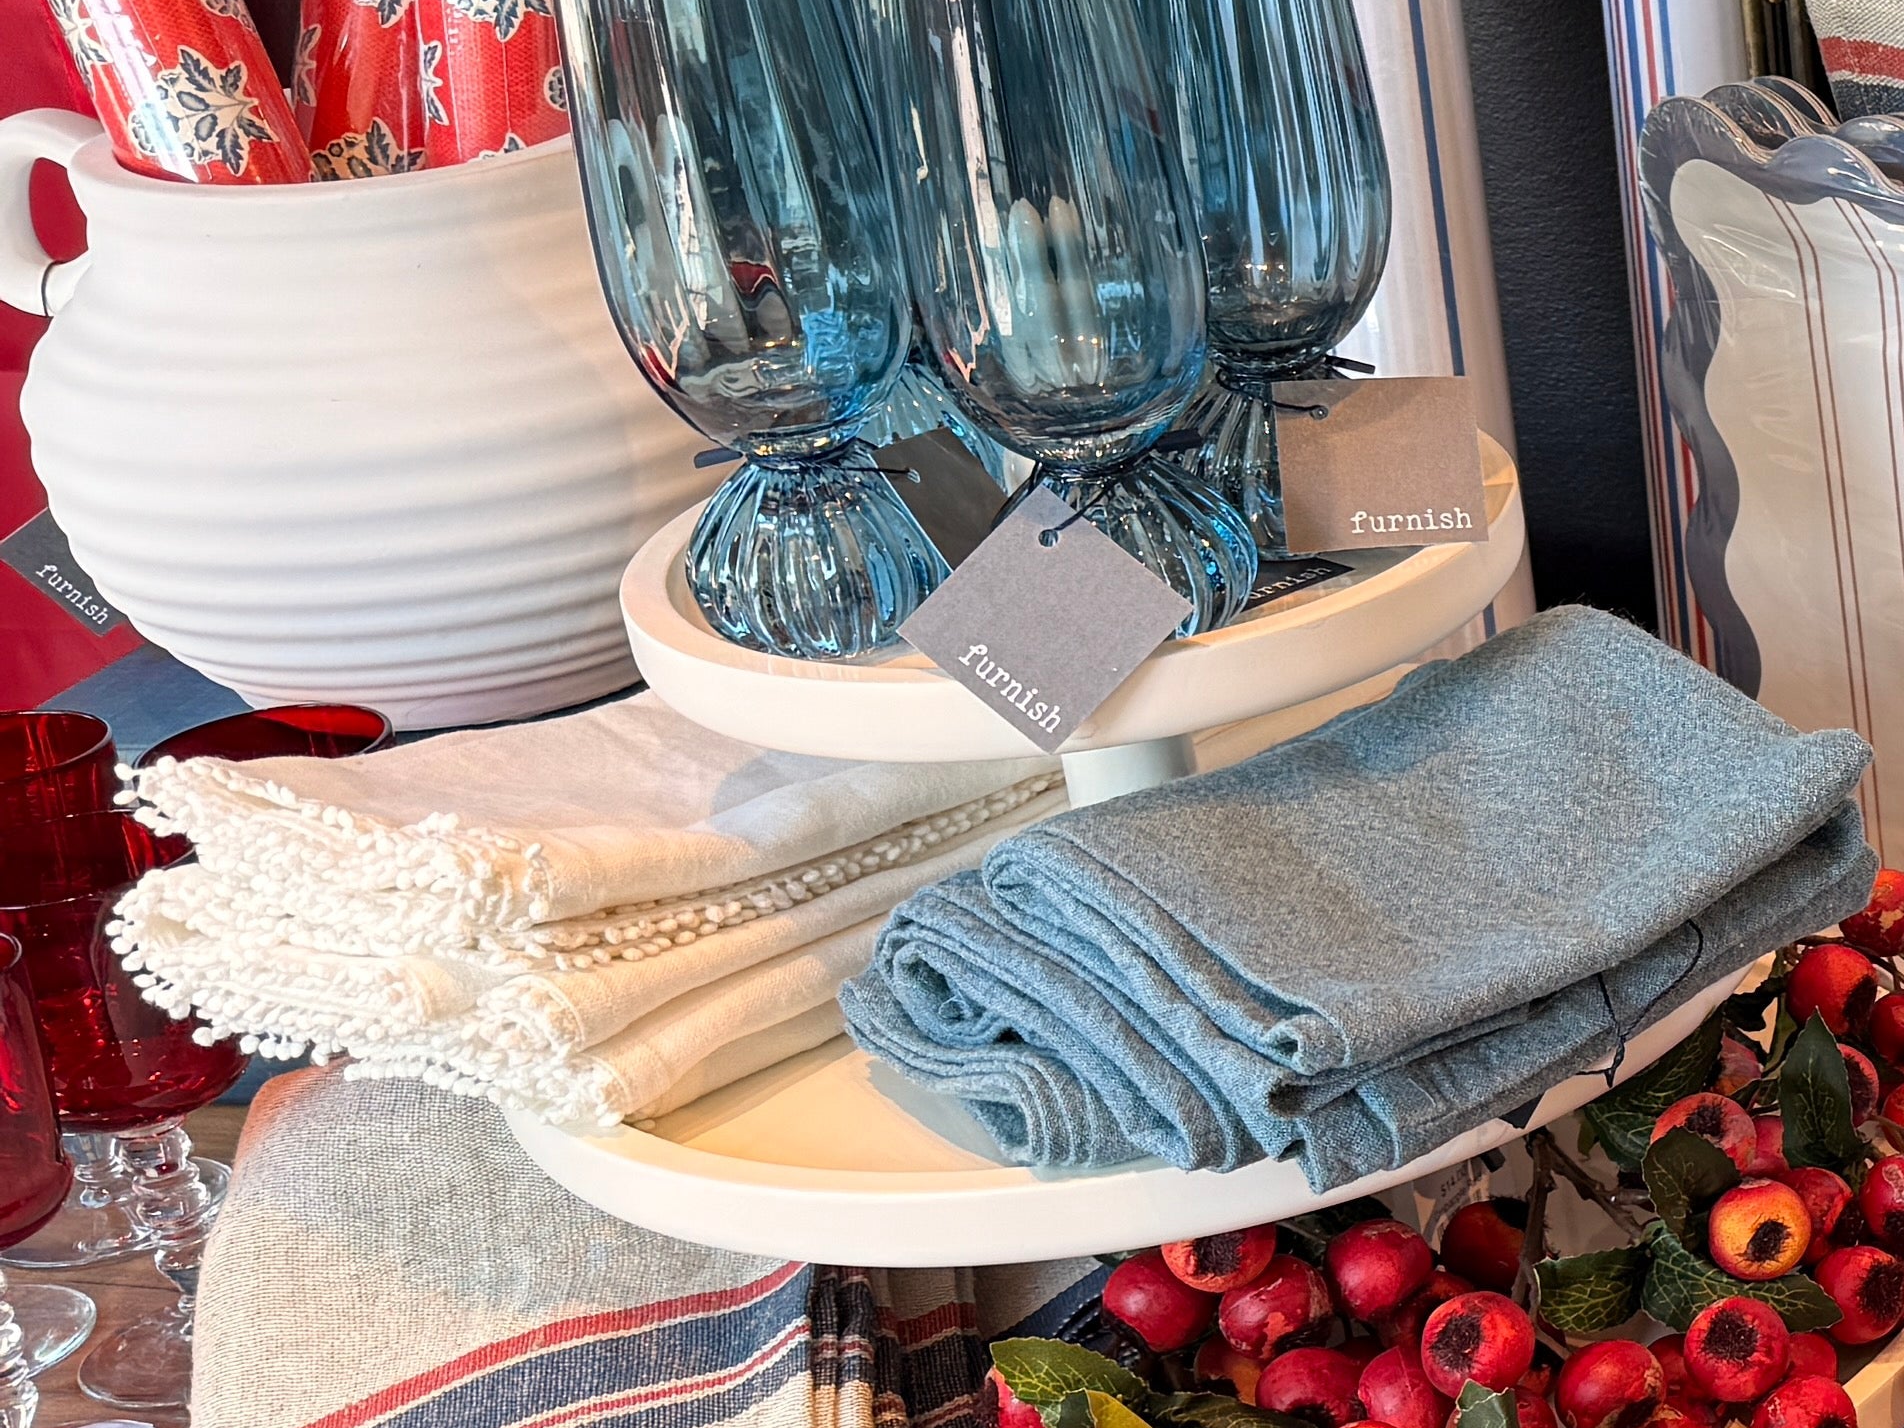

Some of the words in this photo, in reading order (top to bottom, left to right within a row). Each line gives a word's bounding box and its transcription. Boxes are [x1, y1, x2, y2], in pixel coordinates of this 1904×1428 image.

[1350, 508, 1473, 535] furnish
[36, 565, 108, 624] furnish
[1249, 566, 1332, 600] urnish
[957, 643, 1063, 734] furnish
